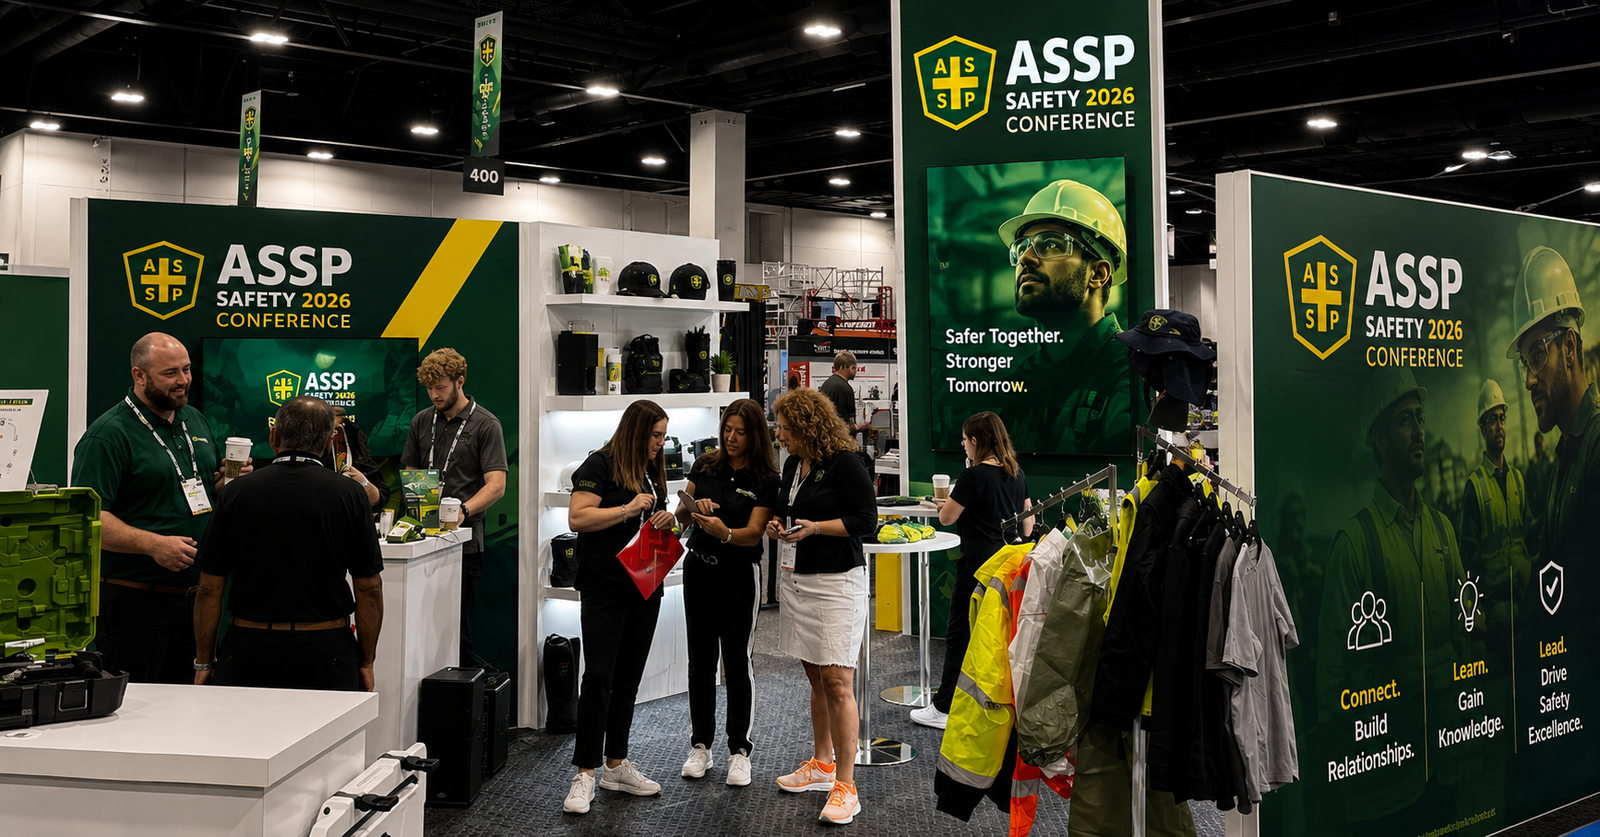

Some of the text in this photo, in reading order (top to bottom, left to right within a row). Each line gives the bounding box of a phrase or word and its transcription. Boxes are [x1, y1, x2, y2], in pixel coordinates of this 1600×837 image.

[934, 56, 975, 75] A S
[1006, 34, 1135, 86] ASSP
[936, 91, 976, 109] S P
[1005, 87, 1135, 110] SAFETY 2026
[1006, 110, 1136, 134] CONFERENCE
[469, 168, 499, 184] 400
[143, 258, 183, 273] A S
[216, 243, 353, 287] ASSP
[1302, 262, 1339, 286] A S
[1364, 249, 1463, 310] ASSP
[145, 287, 183, 302] S P
[216, 290, 351, 309] SAFETY 2026
[216, 312, 351, 329] CONFERENCE
[1305, 308, 1340, 331] S P
[1365, 315, 1463, 341] SAFETY 2026
[945, 326, 1064, 347] Safer Together.
[945, 352, 1014, 373] Stronger
[1366, 345, 1464, 368] CONFERENCE
[304, 372, 356, 391] ASSP
[946, 378, 1028, 394] Tomorrow.
[1539, 635, 1567, 659] Lead.
[1453, 658, 1489, 682] Learn.
[1541, 665, 1568, 687] Drive
[1340, 678, 1401, 711] Connect.
[1458, 688, 1484, 712] Gain
[1539, 691, 1571, 715] Safety
[1354, 712, 1388, 742] Build
[1438, 714, 1505, 749] Knowledge.
[1528, 716, 1583, 745] Excellence.
[1327, 742, 1415, 783] Relationships.
